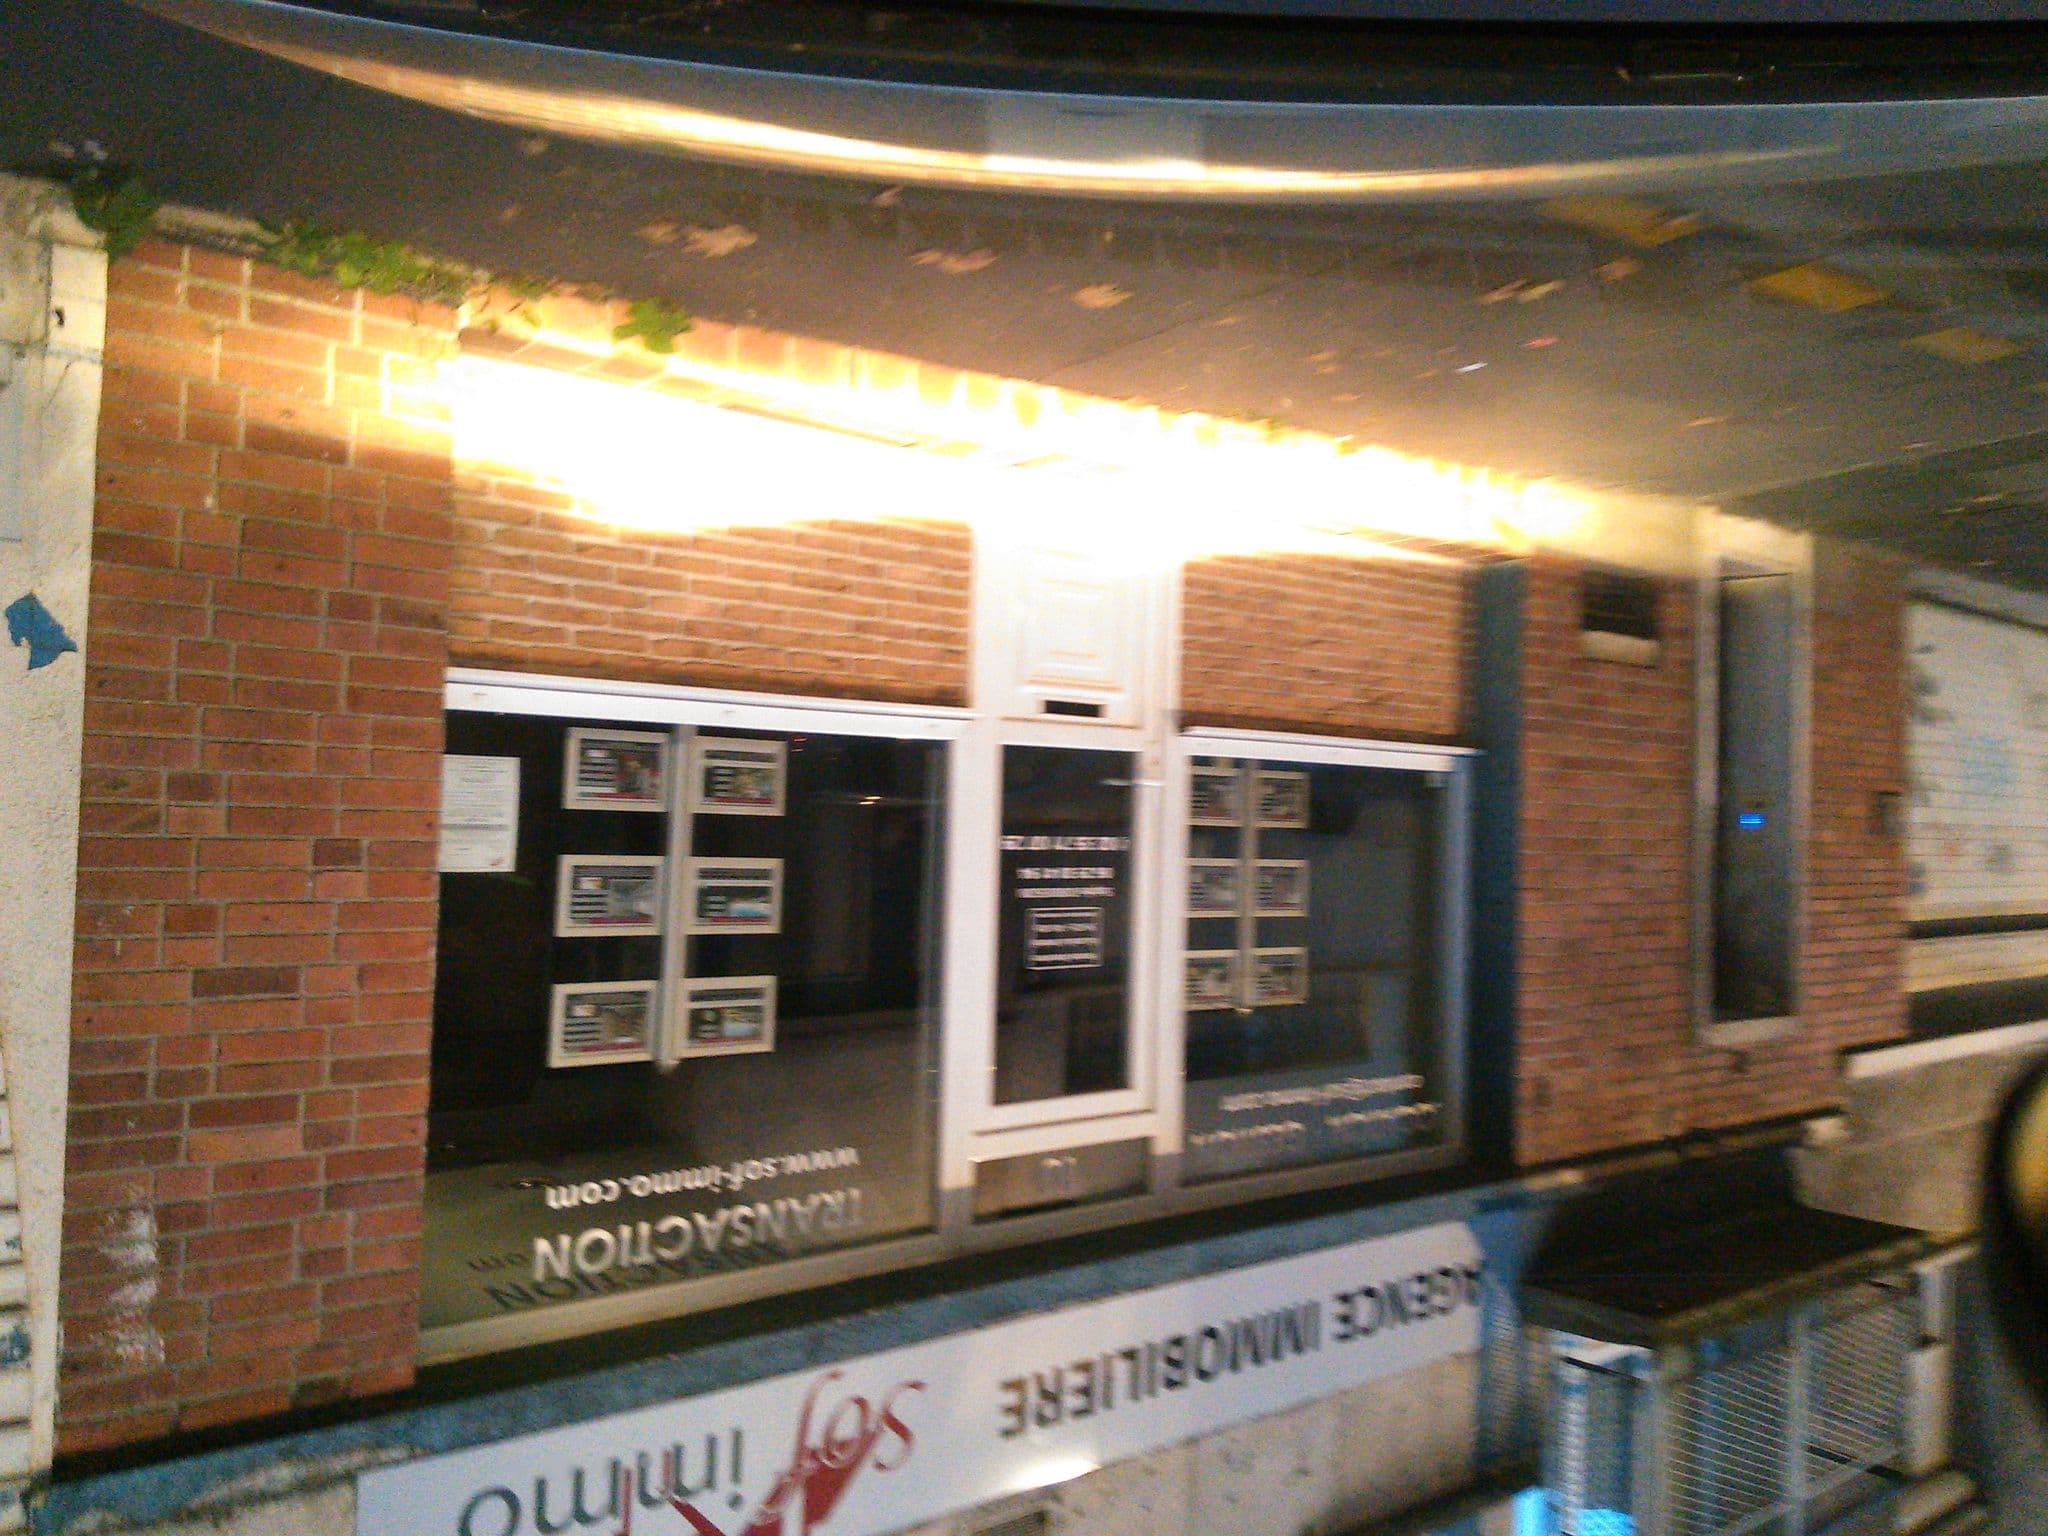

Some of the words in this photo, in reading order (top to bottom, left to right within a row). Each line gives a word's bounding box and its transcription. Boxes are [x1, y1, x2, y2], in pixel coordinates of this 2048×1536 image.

[544, 1146, 860, 1210] www.sof-immo.com
[532, 1187, 863, 1283] TRANSACTION
[1333, 1266, 1481, 1344] AGENCE
[999, 1301, 1321, 1441] IMMOBILIERE
[457, 1428, 746, 1536] immo
